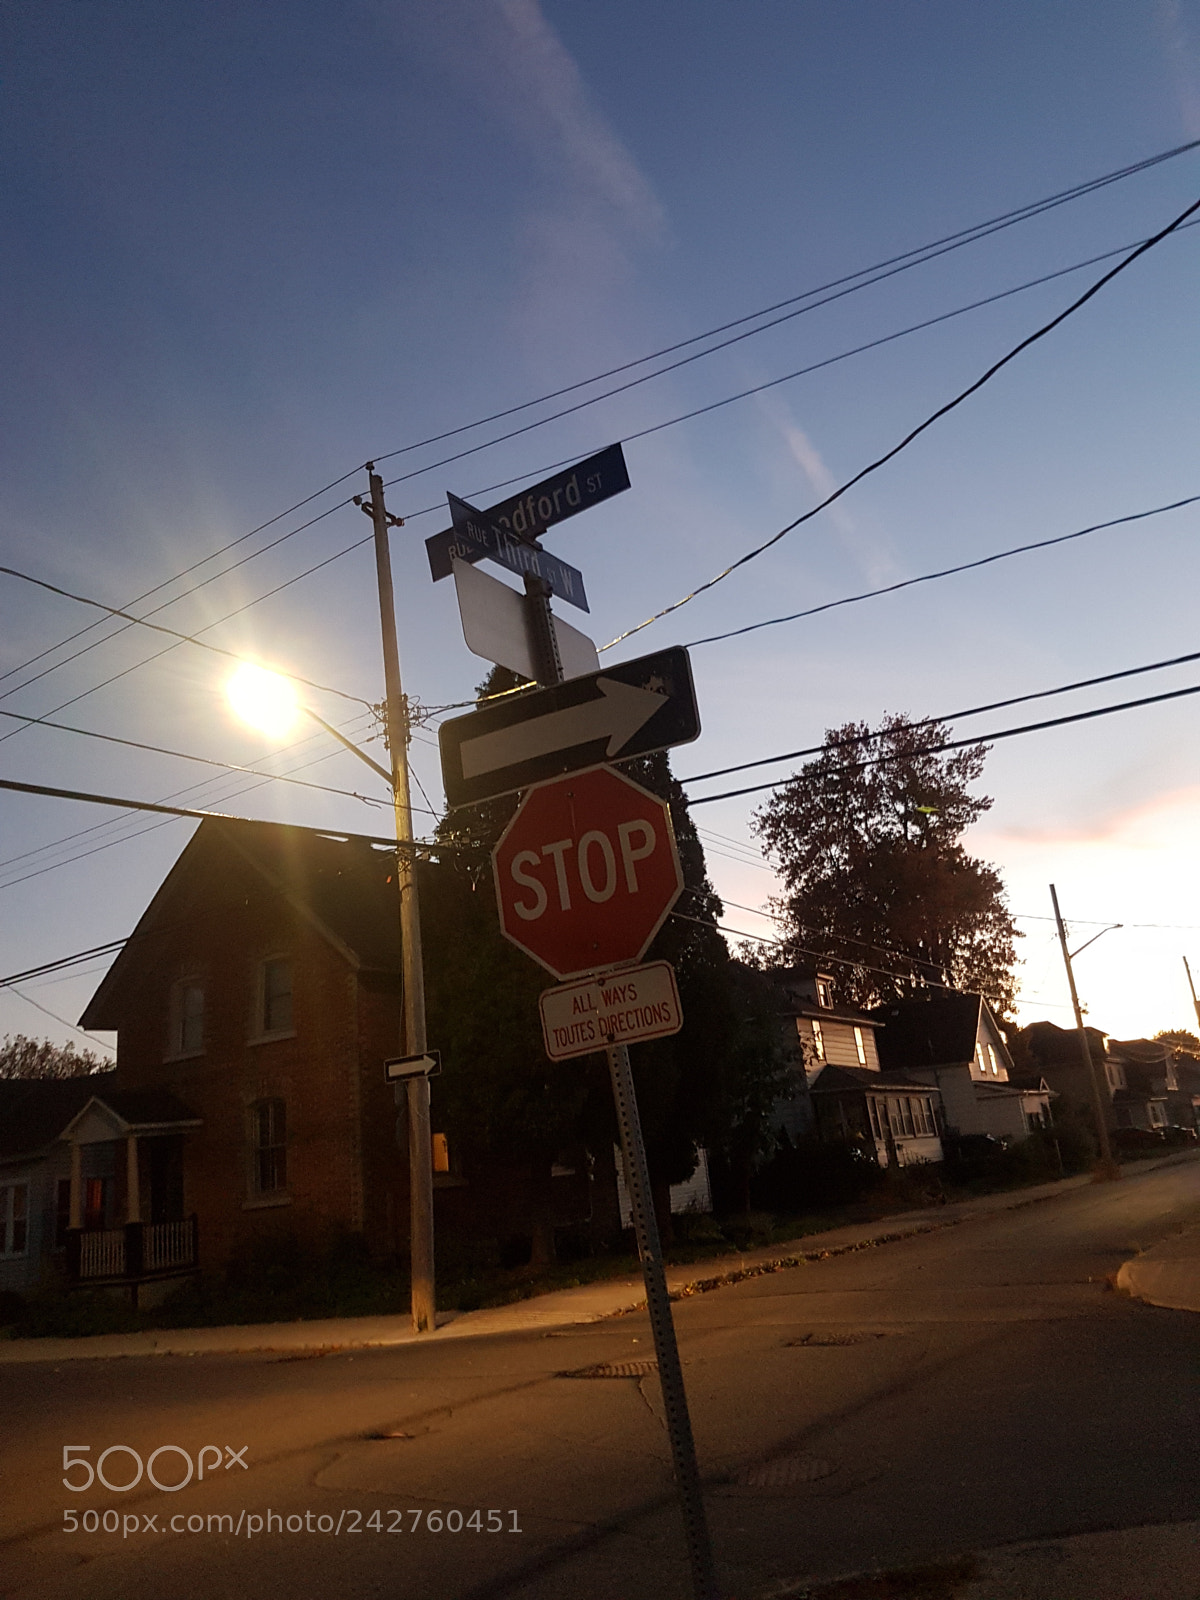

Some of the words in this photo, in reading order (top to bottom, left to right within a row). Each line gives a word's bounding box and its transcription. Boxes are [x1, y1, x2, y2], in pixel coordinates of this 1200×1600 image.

[498, 473, 582, 534] dford
[586, 473, 602, 493] ST
[466, 521, 490, 547] RUE
[491, 525, 543, 578] Third
[559, 565, 574, 597] W
[511, 819, 656, 921] STOP
[553, 1020, 595, 1048] TOUTES
[598, 1002, 671, 1037] DIRECTIONS
[572, 993, 597, 1015] ALL
[601, 983, 638, 1007] WAYS
